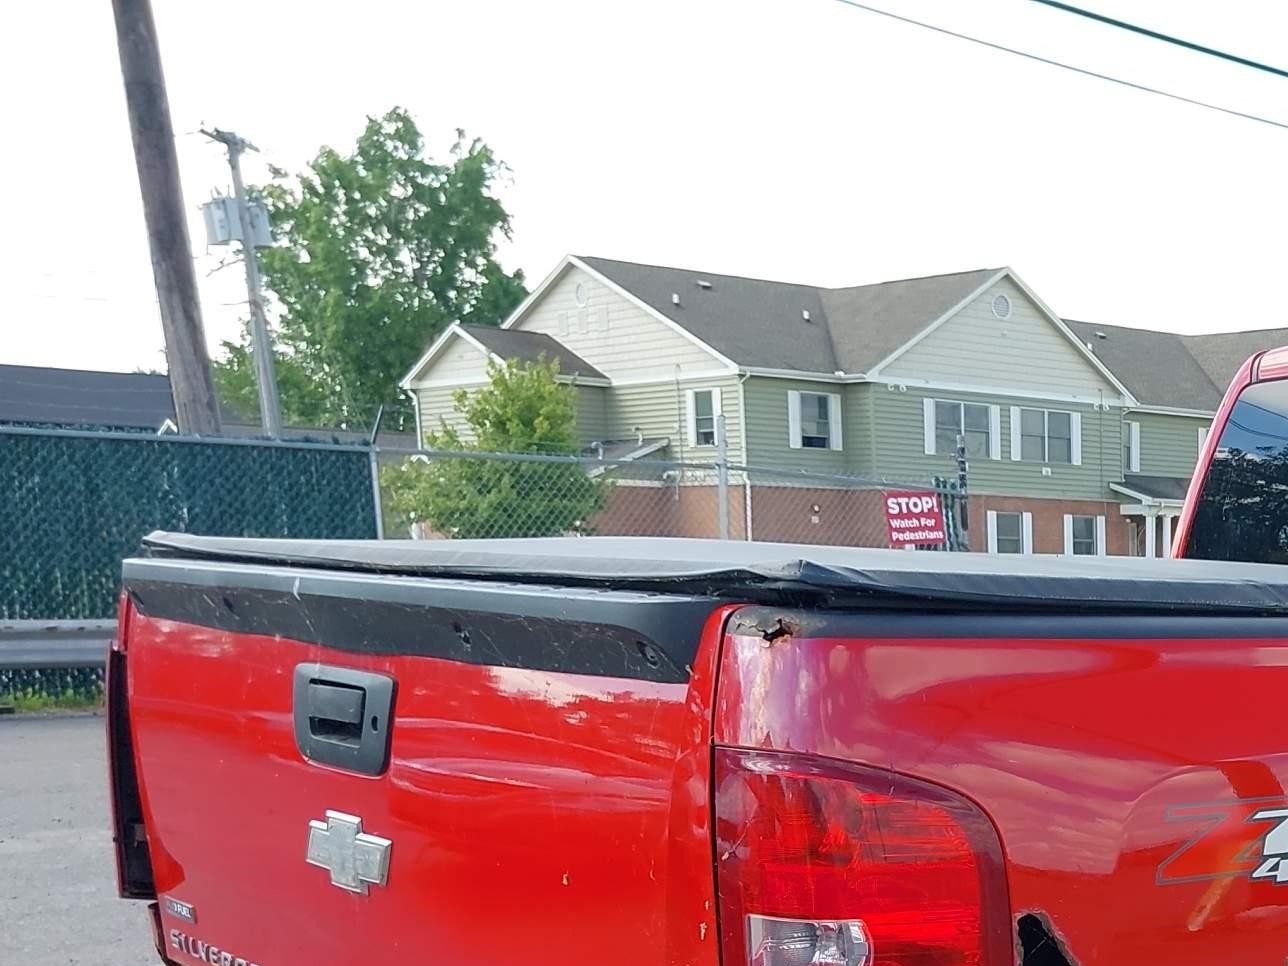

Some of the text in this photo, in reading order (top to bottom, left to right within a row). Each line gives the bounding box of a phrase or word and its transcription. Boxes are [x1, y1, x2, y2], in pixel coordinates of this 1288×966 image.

[887, 496, 938, 514] STOP!
[889, 517, 936, 528] Watch For
[891, 530, 944, 541] Pedestrians
